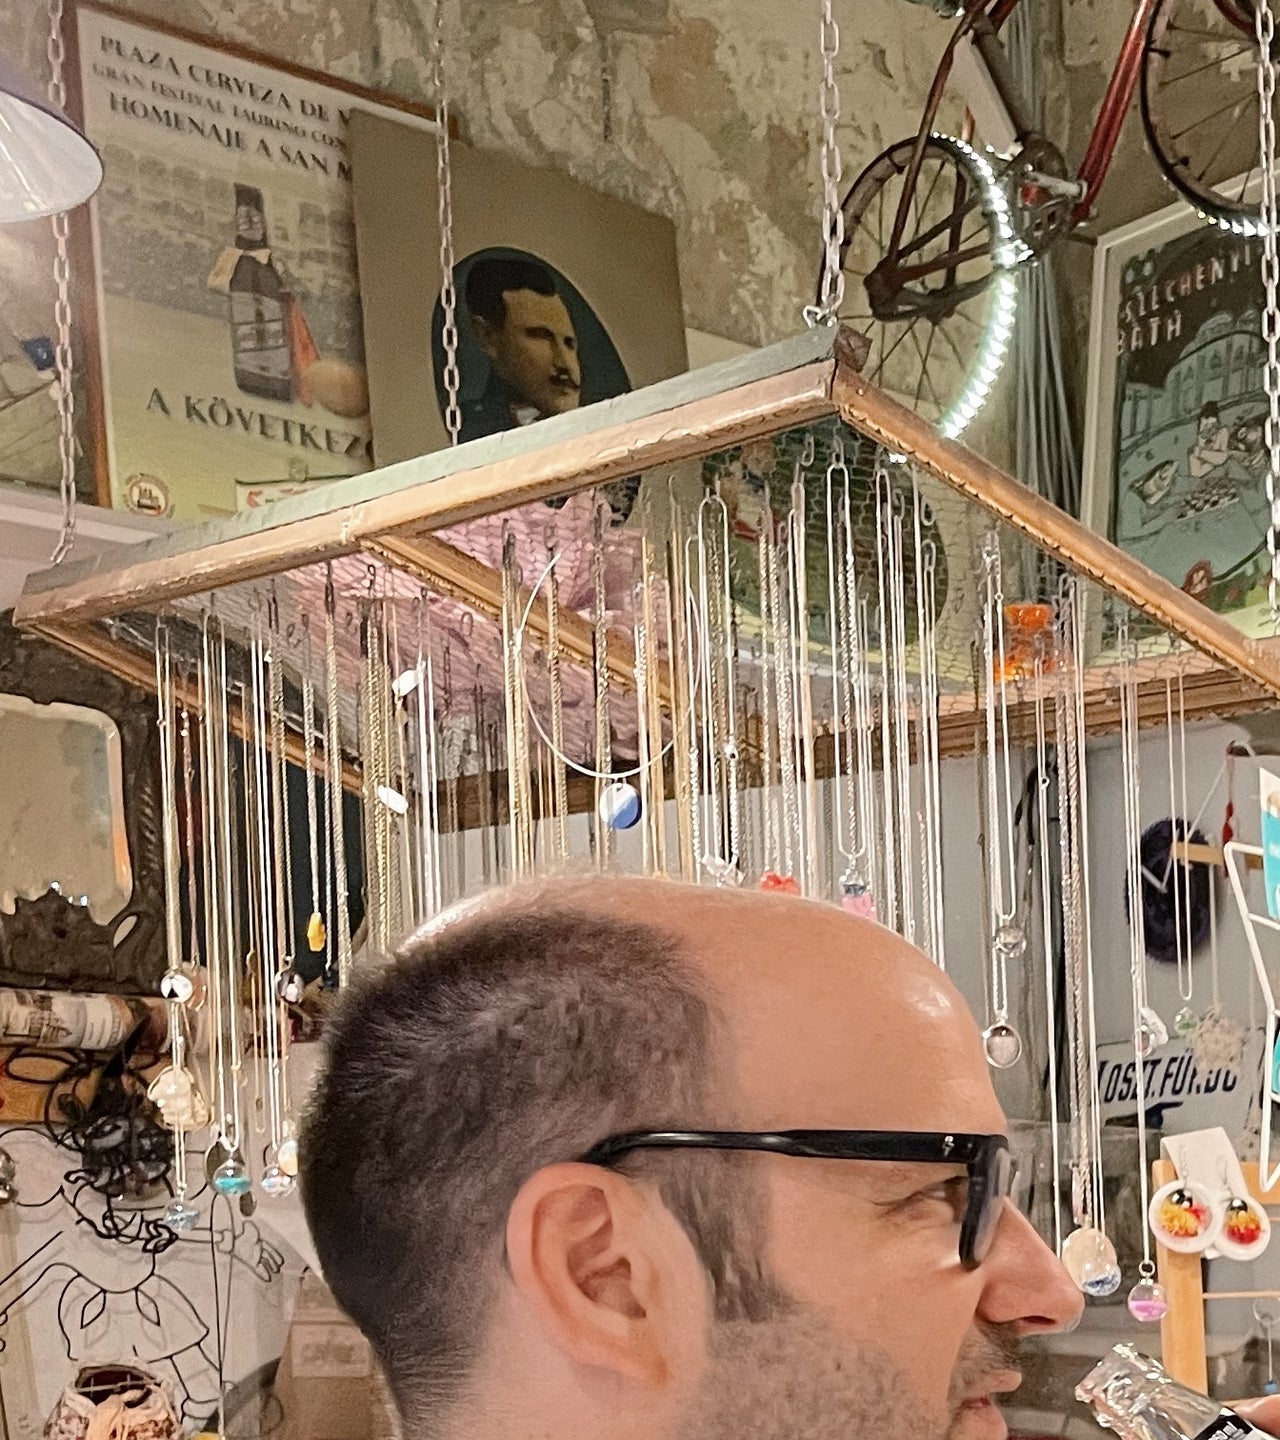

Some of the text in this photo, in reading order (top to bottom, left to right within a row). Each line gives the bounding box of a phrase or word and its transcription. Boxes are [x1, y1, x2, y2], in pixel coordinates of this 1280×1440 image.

[100, 36, 181, 78] PLAZA
[188, 64, 292, 113] CERVEZA
[299, 98, 330, 122] DE
[110, 92, 247, 151] HOMENAJE
[256, 137, 273, 159] A
[280, 143, 330, 176] SAN
[147, 387, 171, 416] A
